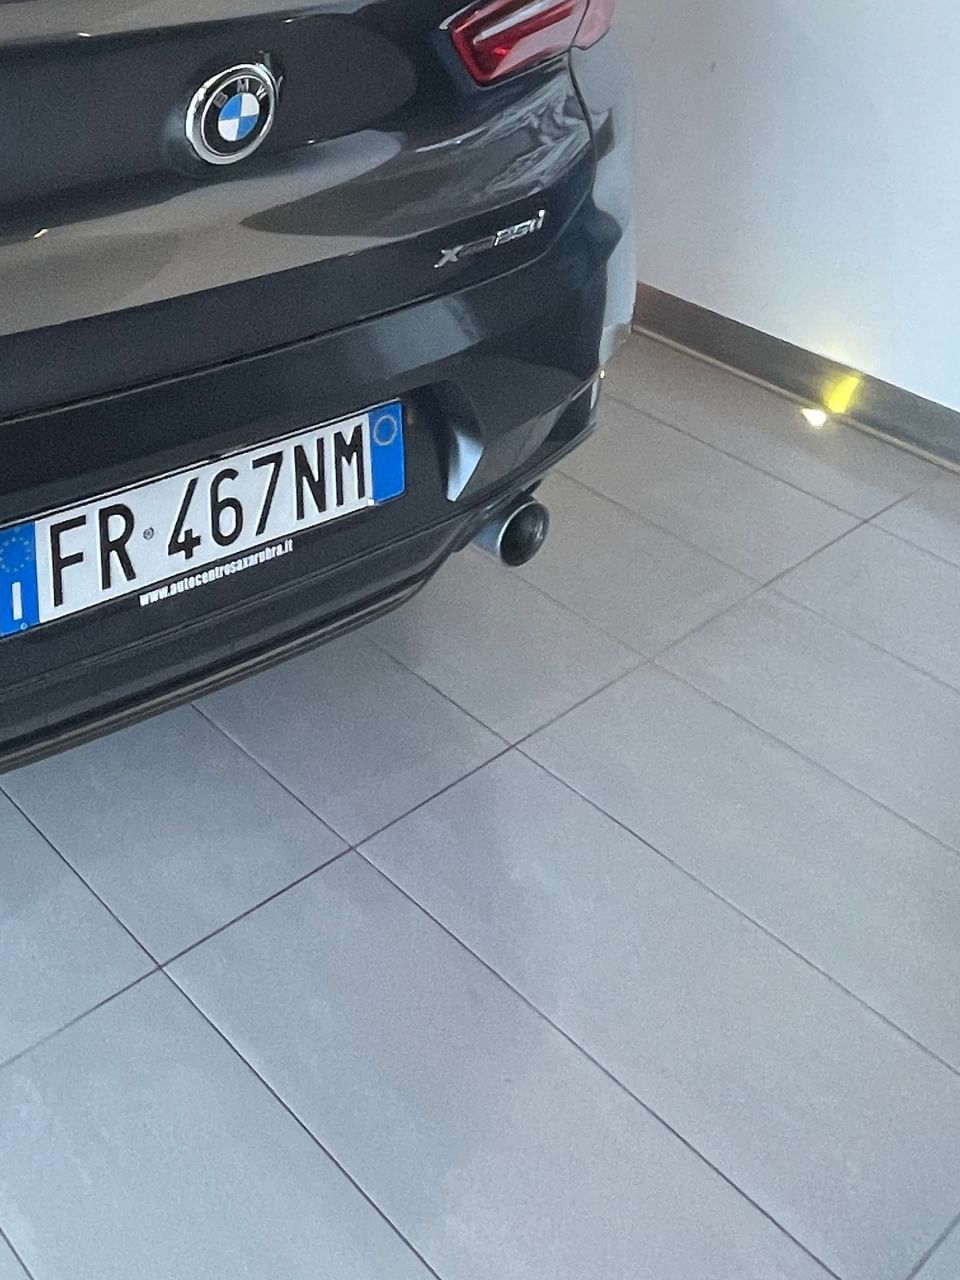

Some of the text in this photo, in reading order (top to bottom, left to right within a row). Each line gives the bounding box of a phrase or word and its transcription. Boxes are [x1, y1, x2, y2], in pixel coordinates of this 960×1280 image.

[49, 423, 366, 608] FR 467NM
[139, 540, 294, 607] www.autocentrosaxarubra.it
